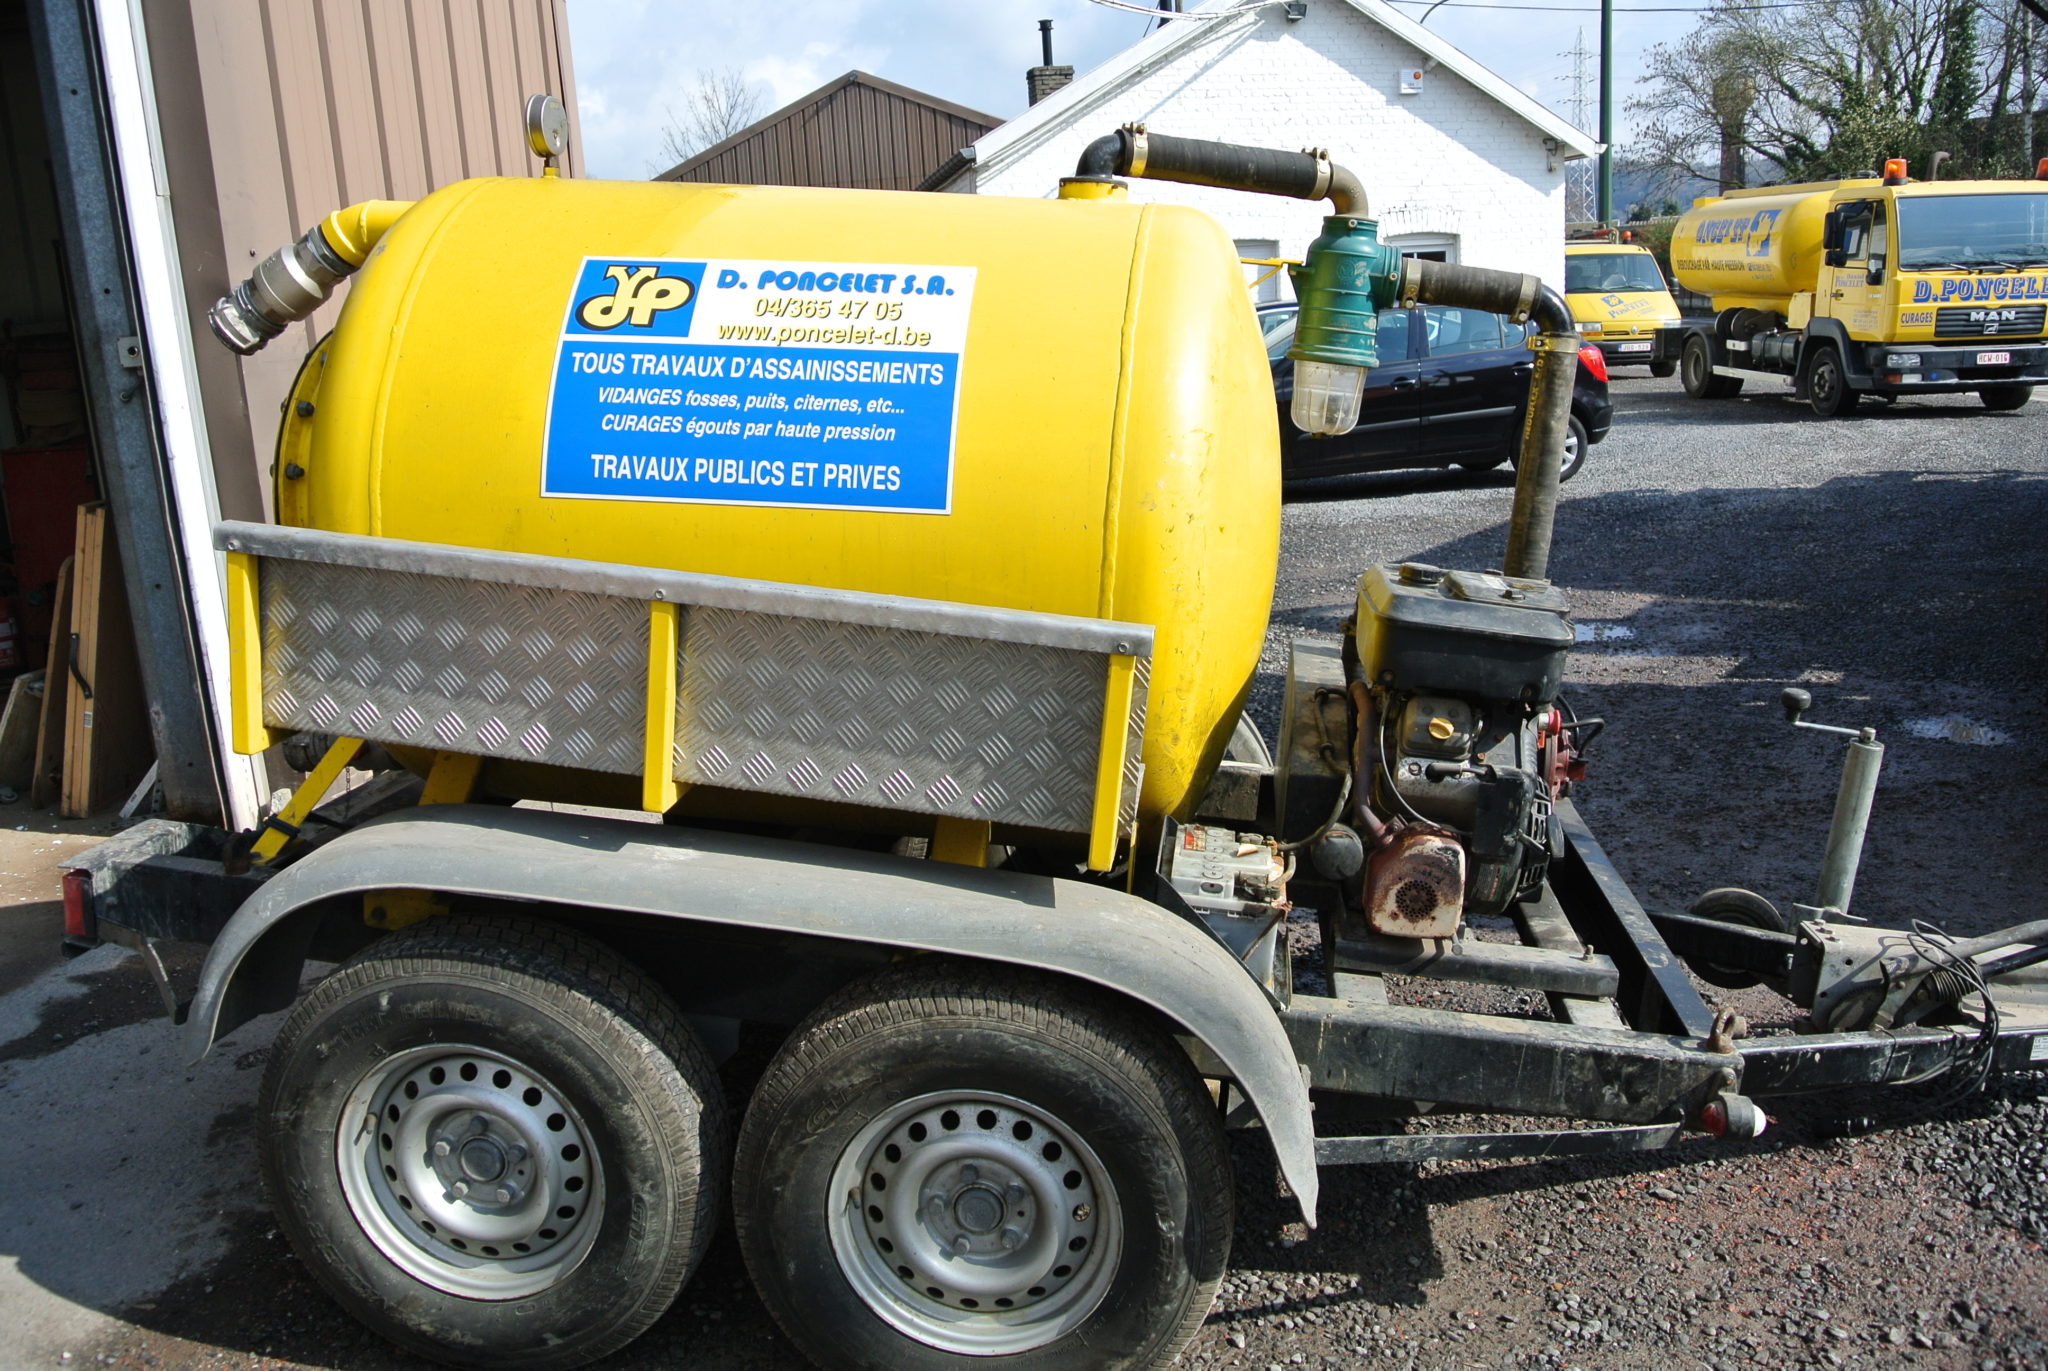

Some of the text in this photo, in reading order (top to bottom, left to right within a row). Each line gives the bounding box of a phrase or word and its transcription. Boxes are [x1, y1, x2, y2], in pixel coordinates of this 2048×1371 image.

[717, 269, 955, 296] D. PONCELET S.A.
[753, 298, 903, 320] 04/365 47 05
[1900, 312, 1934, 324] CURAGES
[1970, 311, 2016, 321] MAN
[718, 324, 931, 346] www.poncelet-d.be
[571, 352, 944, 385] TOUS TRAVAUX D'ASSAINISSEMENTS
[598, 387, 905, 415] VIDANGES fosses, puits, citernes, etc...
[601, 413, 895, 442] CURAGES égouts par haute pression
[591, 454, 901, 490] TRAVAUX PUBLICS ET PRIVES
